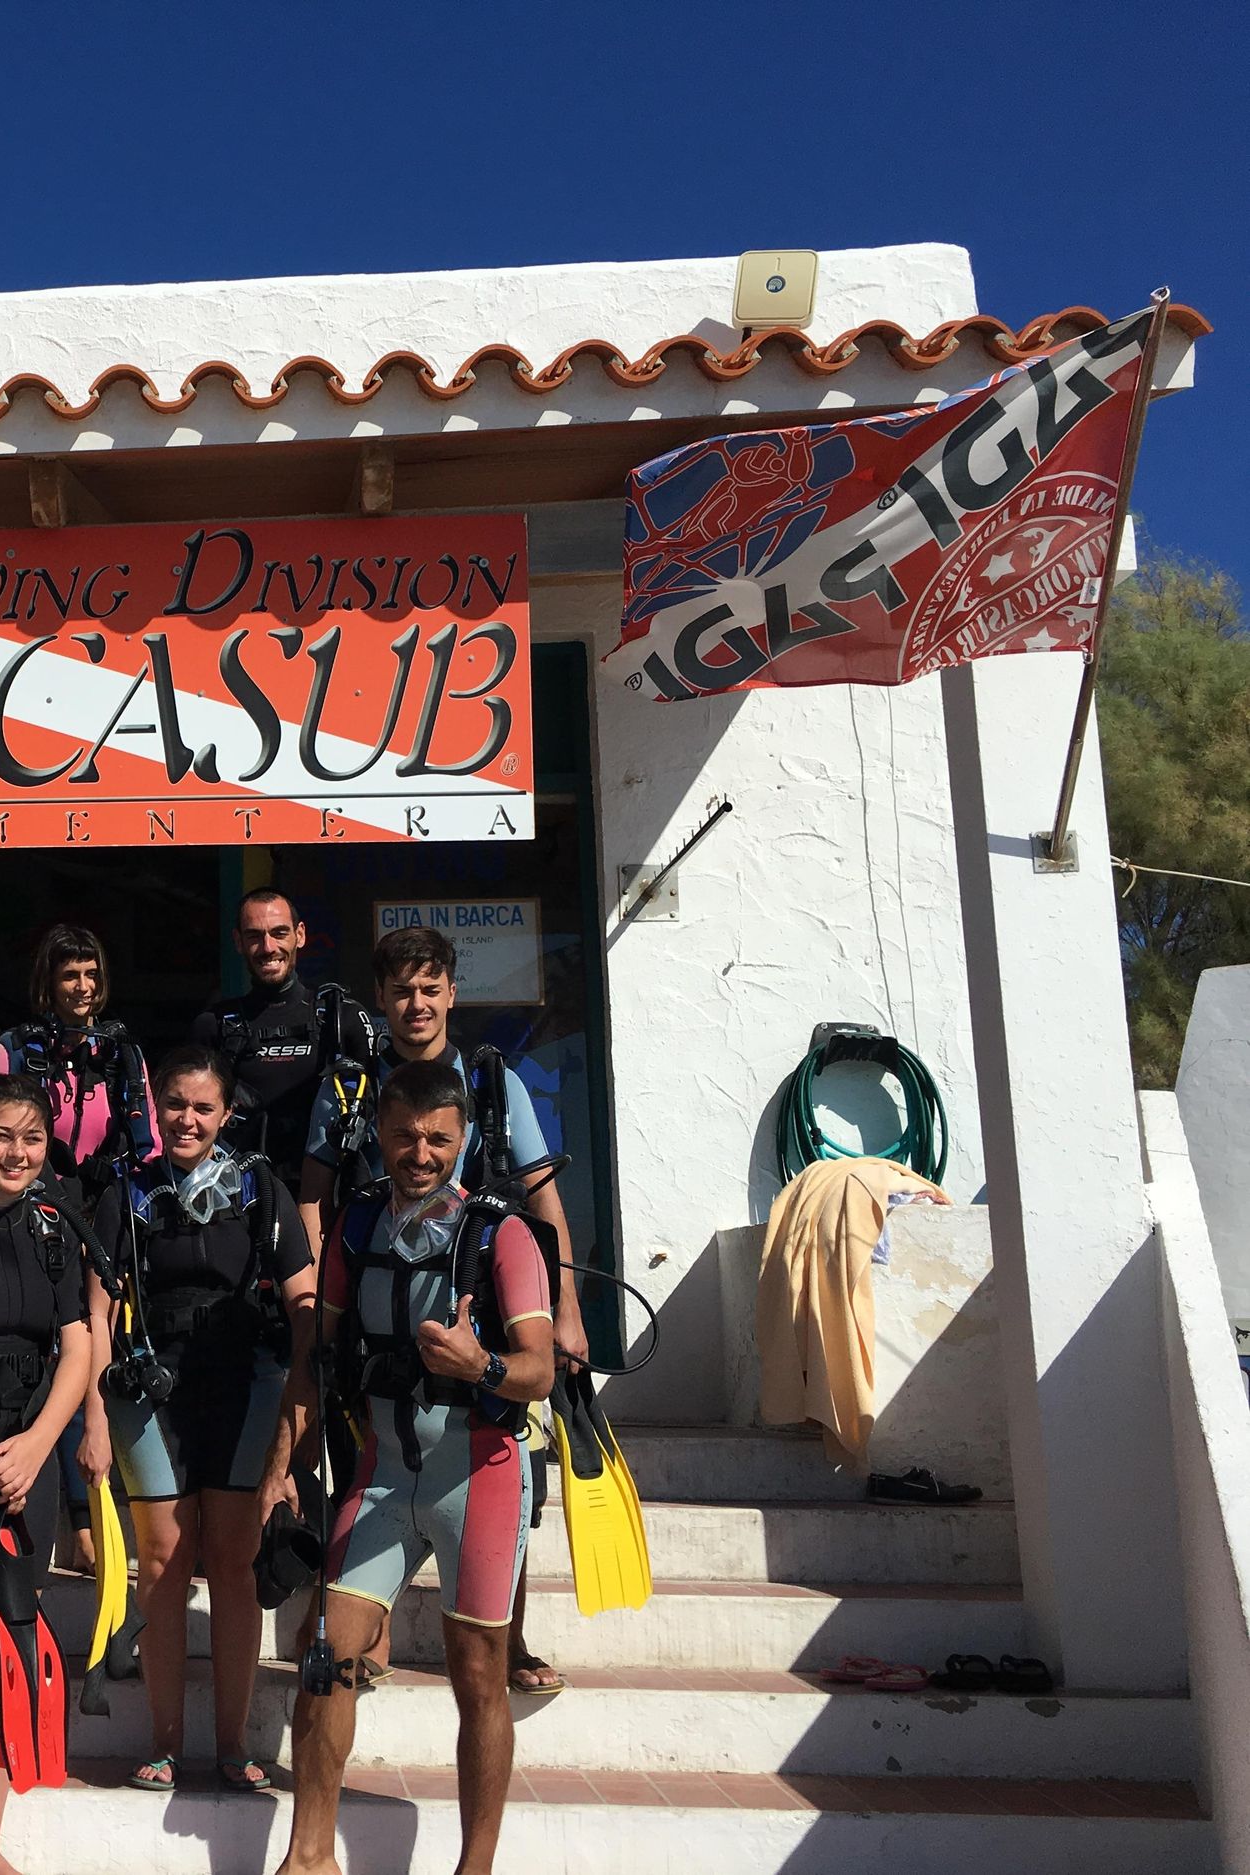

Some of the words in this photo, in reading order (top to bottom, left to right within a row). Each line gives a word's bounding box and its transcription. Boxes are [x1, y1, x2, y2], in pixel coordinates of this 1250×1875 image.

[162, 527, 518, 617] DIVISION
[382, 907, 423, 928] GITA
[430, 906, 449, 928] IN
[455, 905, 524, 926] BARCA
[255, 1045, 312, 1057] RESSI
